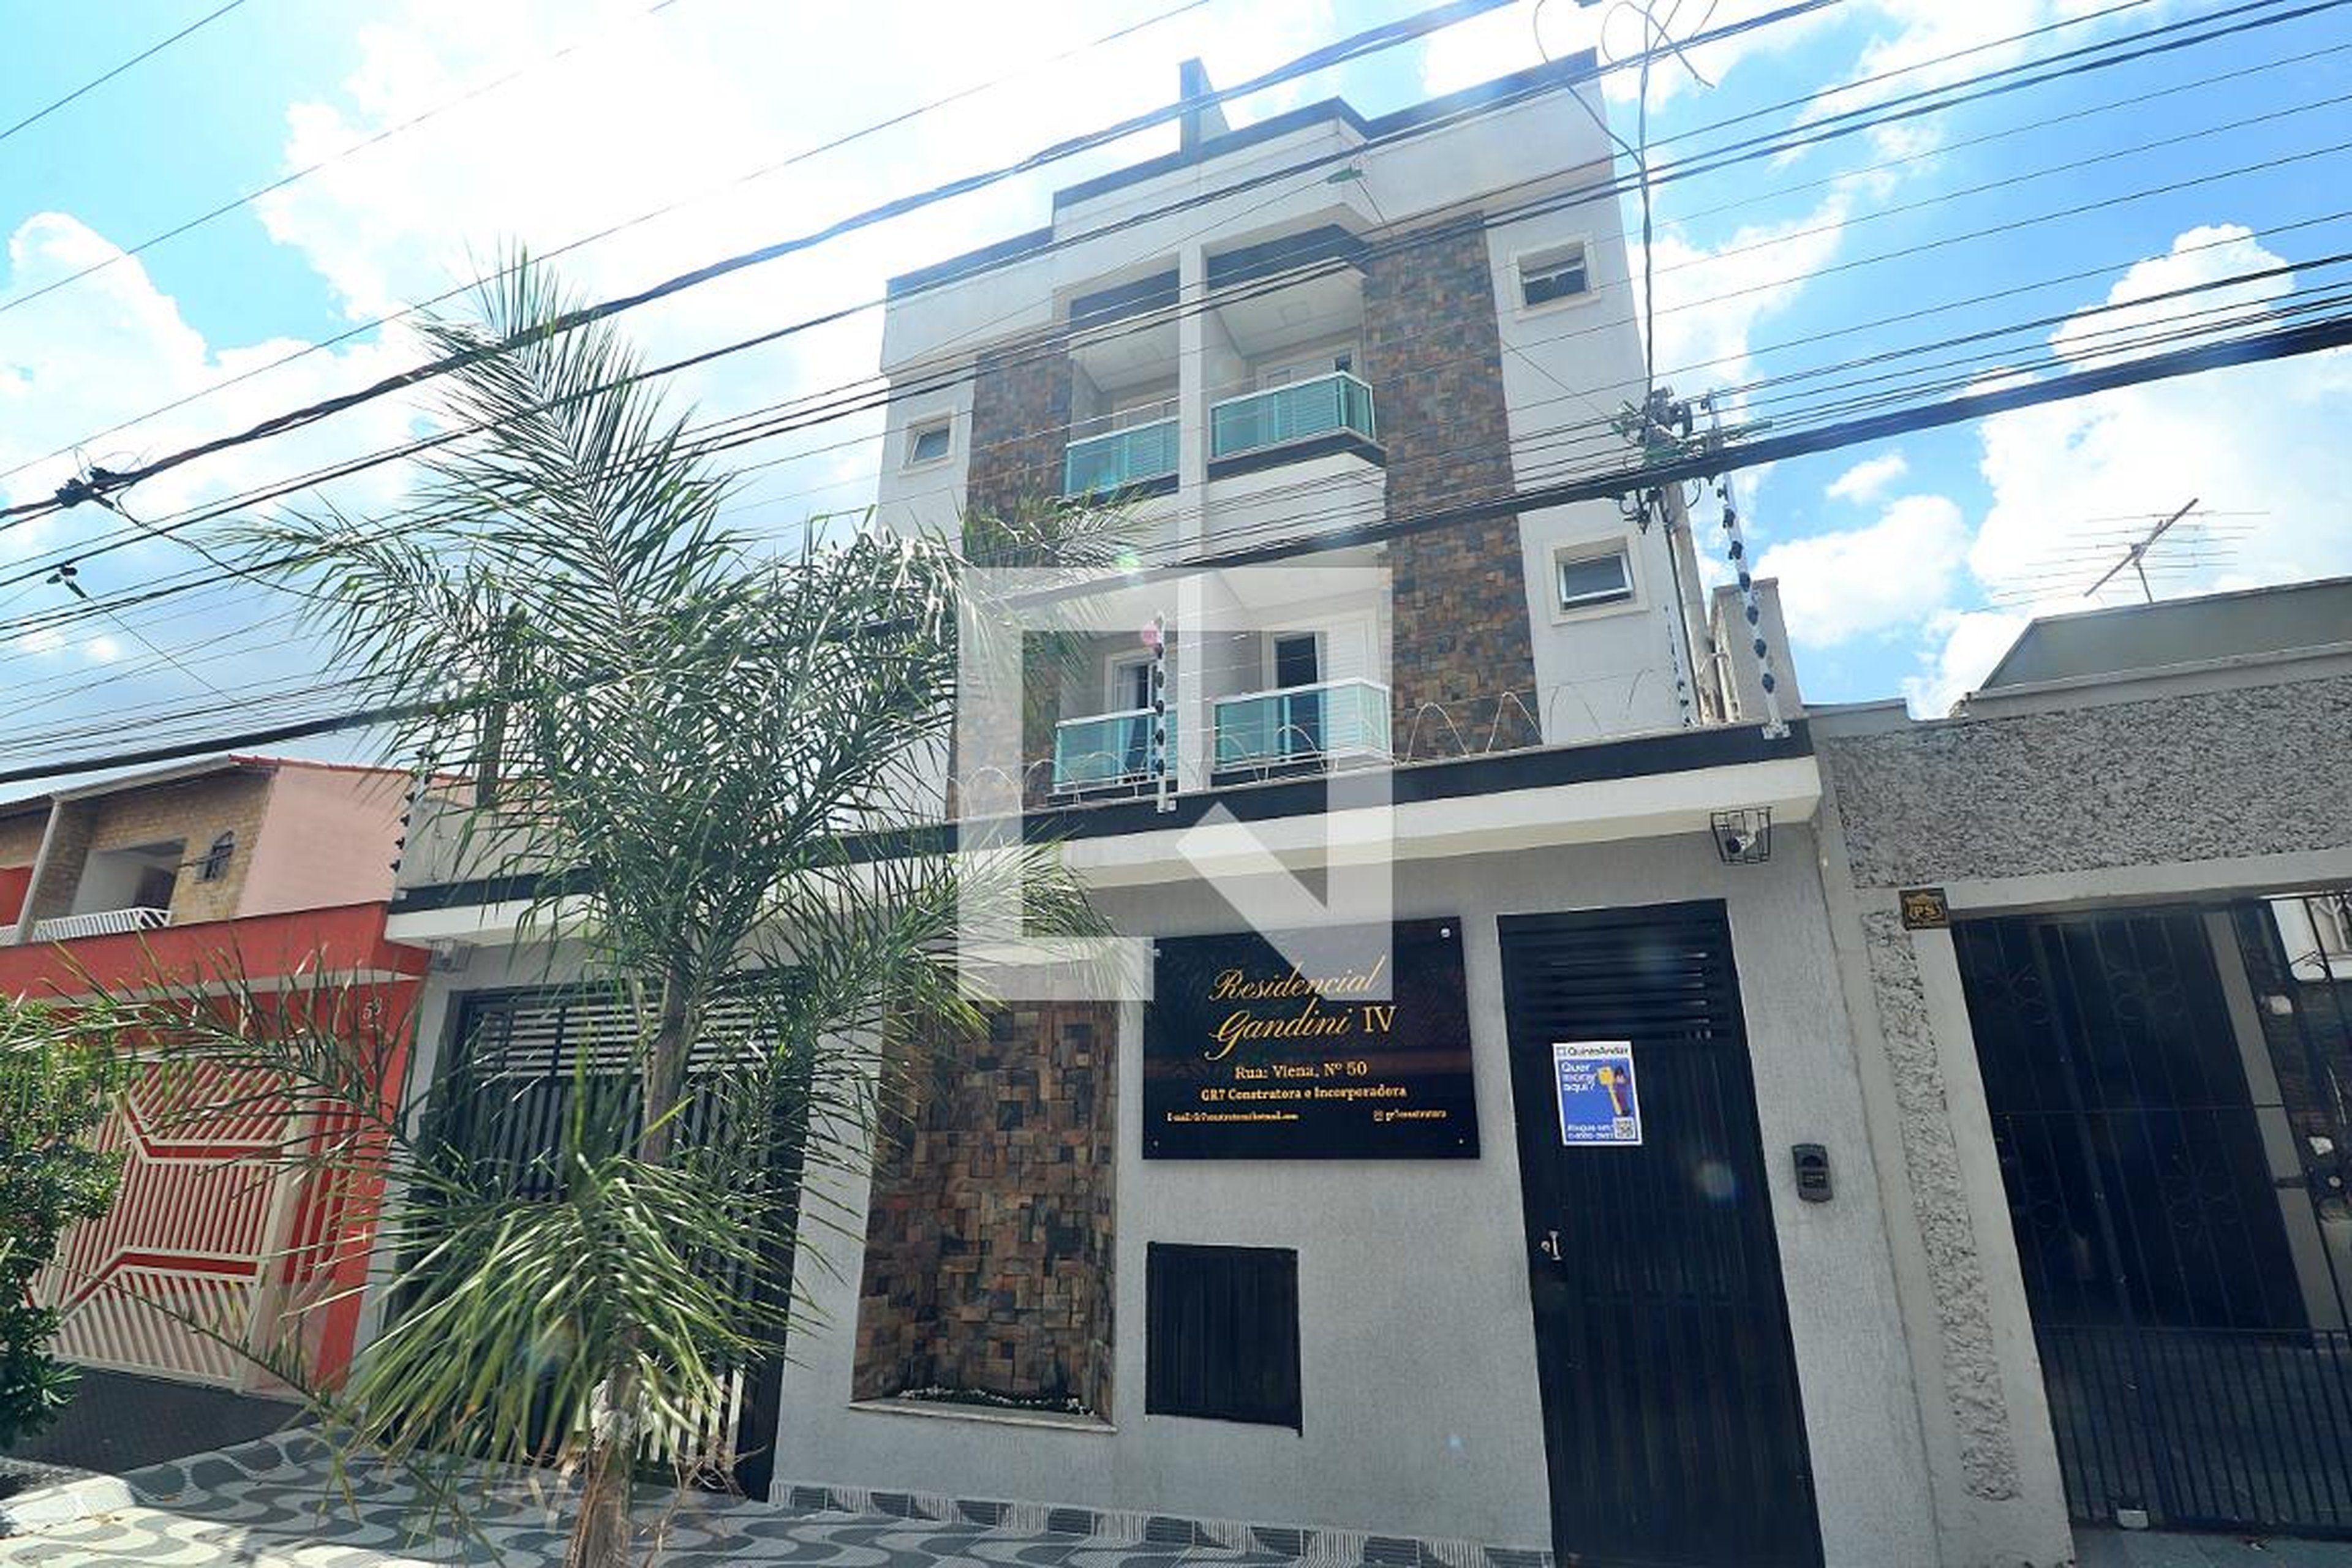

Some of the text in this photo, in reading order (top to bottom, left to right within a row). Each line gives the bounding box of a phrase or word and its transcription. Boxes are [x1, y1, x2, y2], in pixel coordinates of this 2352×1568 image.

[1208, 954, 1385, 1001] Residencial
[1204, 997, 1396, 1060] Gandini IV
[1235, 1066, 1268, 1080] Rua:
[1347, 1060, 1368, 1076] 50
[1561, 1061, 1591, 1072] Quer
[1201, 1088, 1226, 1101] GR7
[1227, 1087, 1301, 1100] Construtora
[1314, 1084, 1407, 1101] Incorporadora
